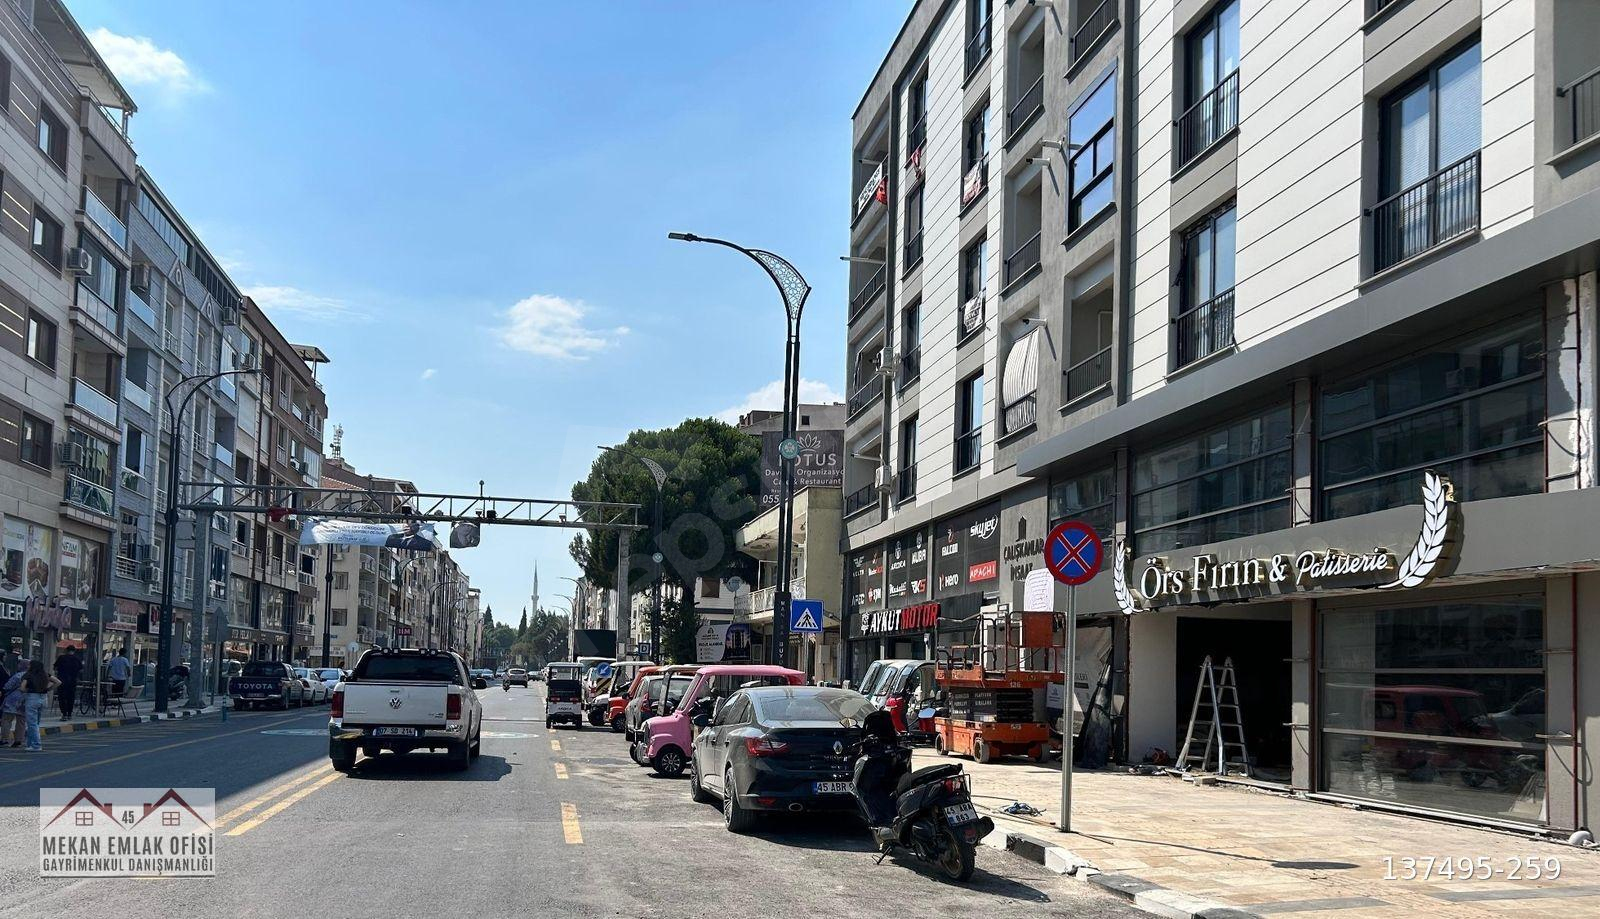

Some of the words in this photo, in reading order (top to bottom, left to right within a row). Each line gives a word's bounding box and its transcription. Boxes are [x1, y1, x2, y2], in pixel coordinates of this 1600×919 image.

[800, 477, 842, 485] Restaurant
[1140, 556, 1184, 600] Örs
[1268, 554, 1286, 583] &
[1295, 547, 1389, 586] Patisserie
[0, 602, 23, 621] LER
[870, 609, 902, 633] AYKUT
[901, 603, 939, 630] MOTOR
[818, 782, 829, 792] 45
[831, 782, 847, 792] ABR
